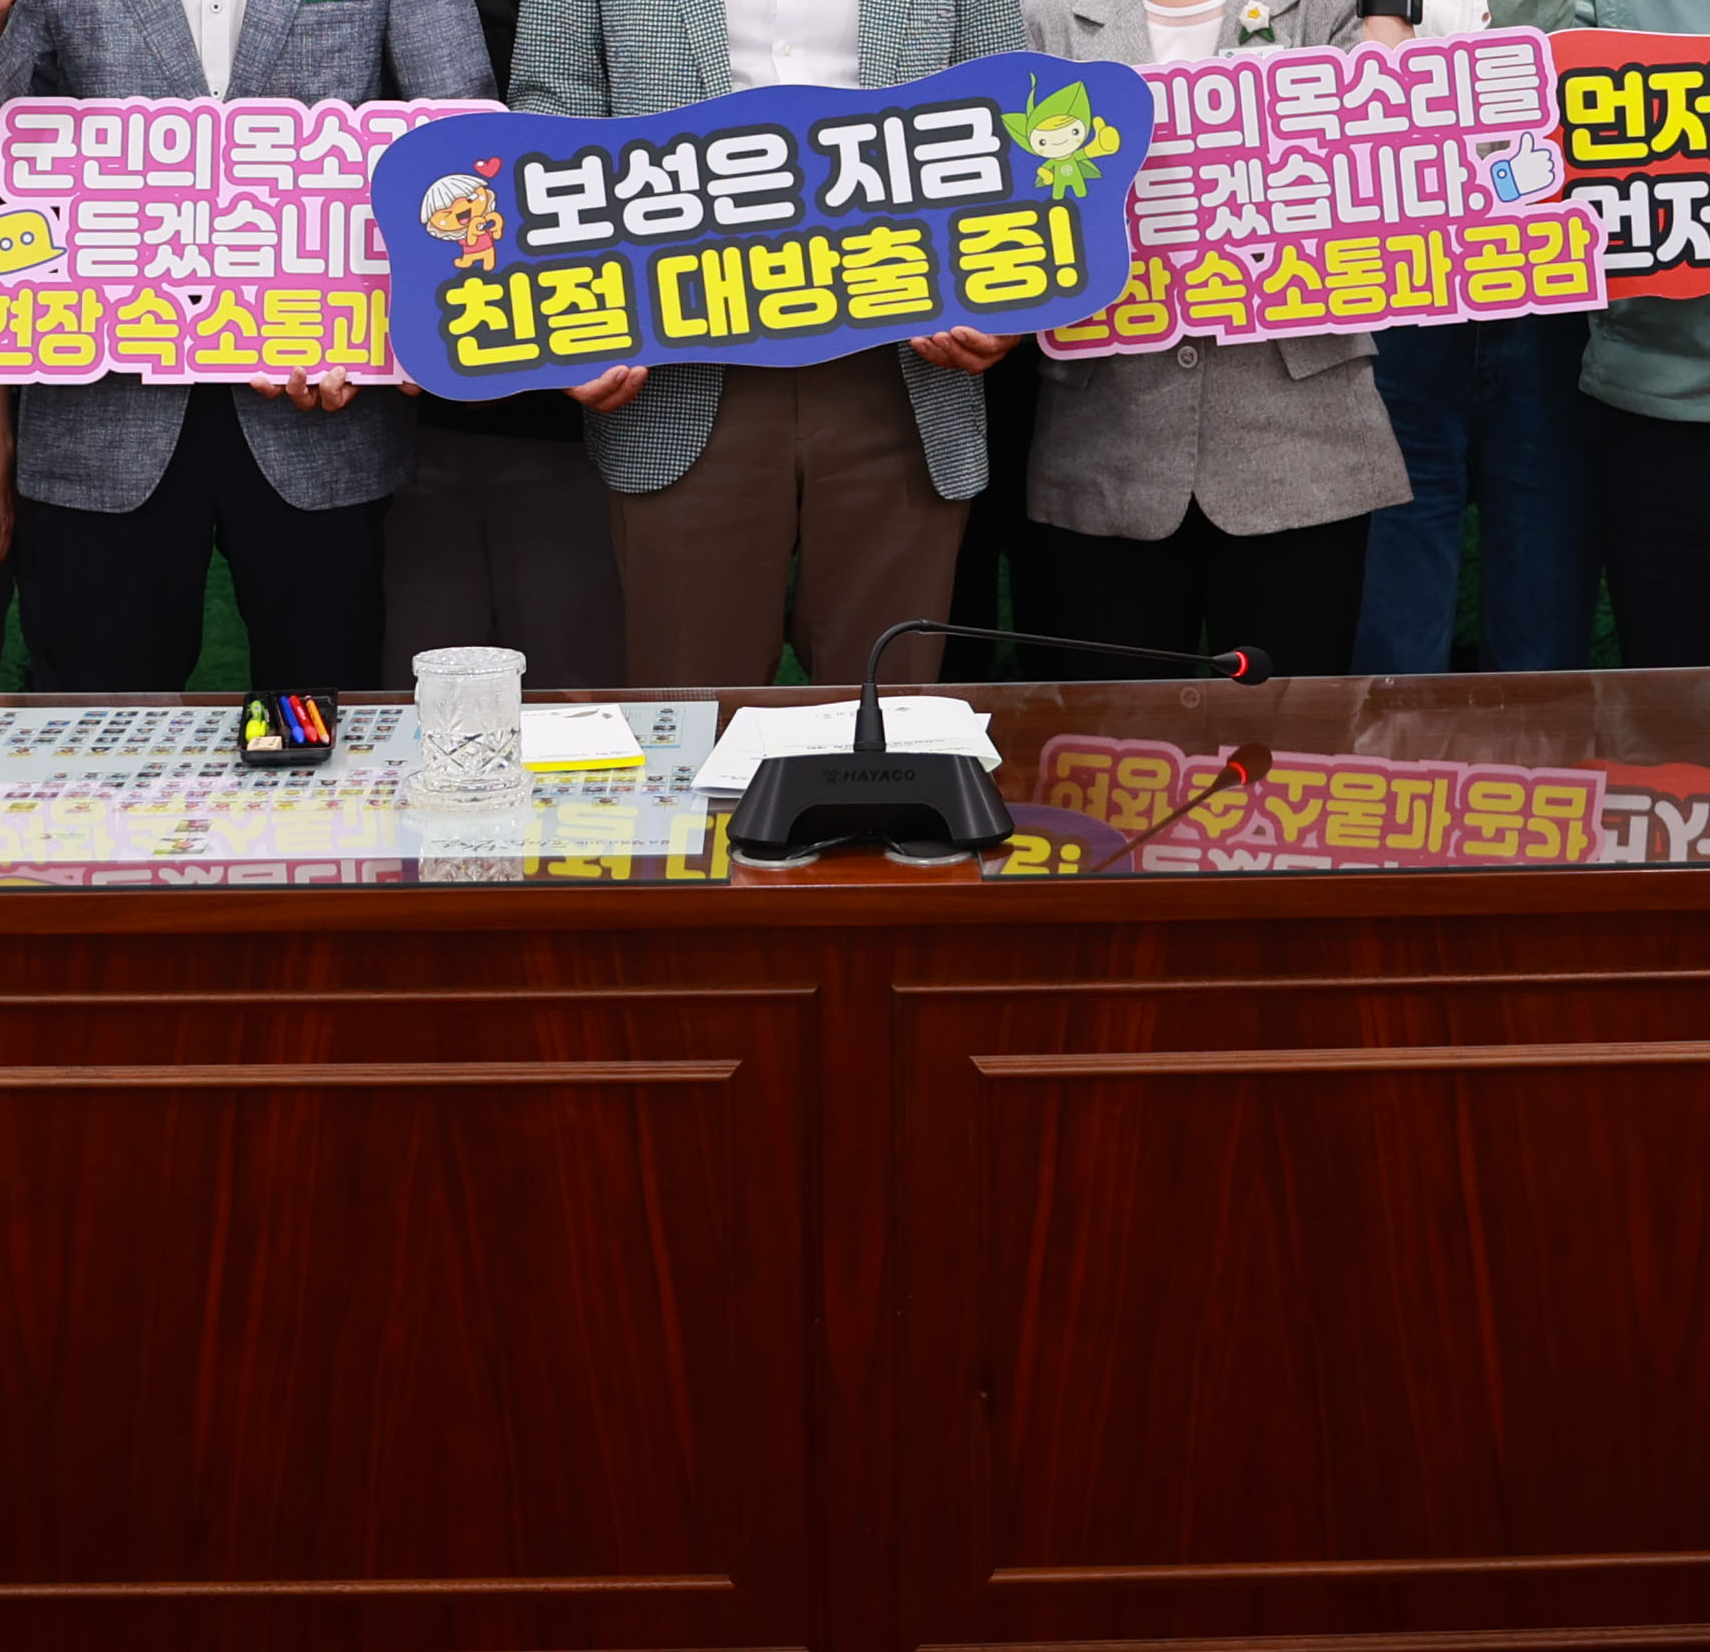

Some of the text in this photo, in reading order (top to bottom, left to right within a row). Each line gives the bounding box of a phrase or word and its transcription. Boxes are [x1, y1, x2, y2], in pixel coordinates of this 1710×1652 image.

[1273, 43, 1543, 139] 목소리를
[10, 113, 214, 190] 군민의
[524, 106, 1004, 246] 보성은 지금
[1133, 141, 1486, 246] 듣겠습니다.
[116, 288, 180, 366] 속
[195, 289, 389, 367] 소통과
[445, 204, 1079, 367] 친절 대방출 중!
[1051, 216, 1591, 343] 장 속 소통과 공감
[843, 769, 917, 782] HAYACO
